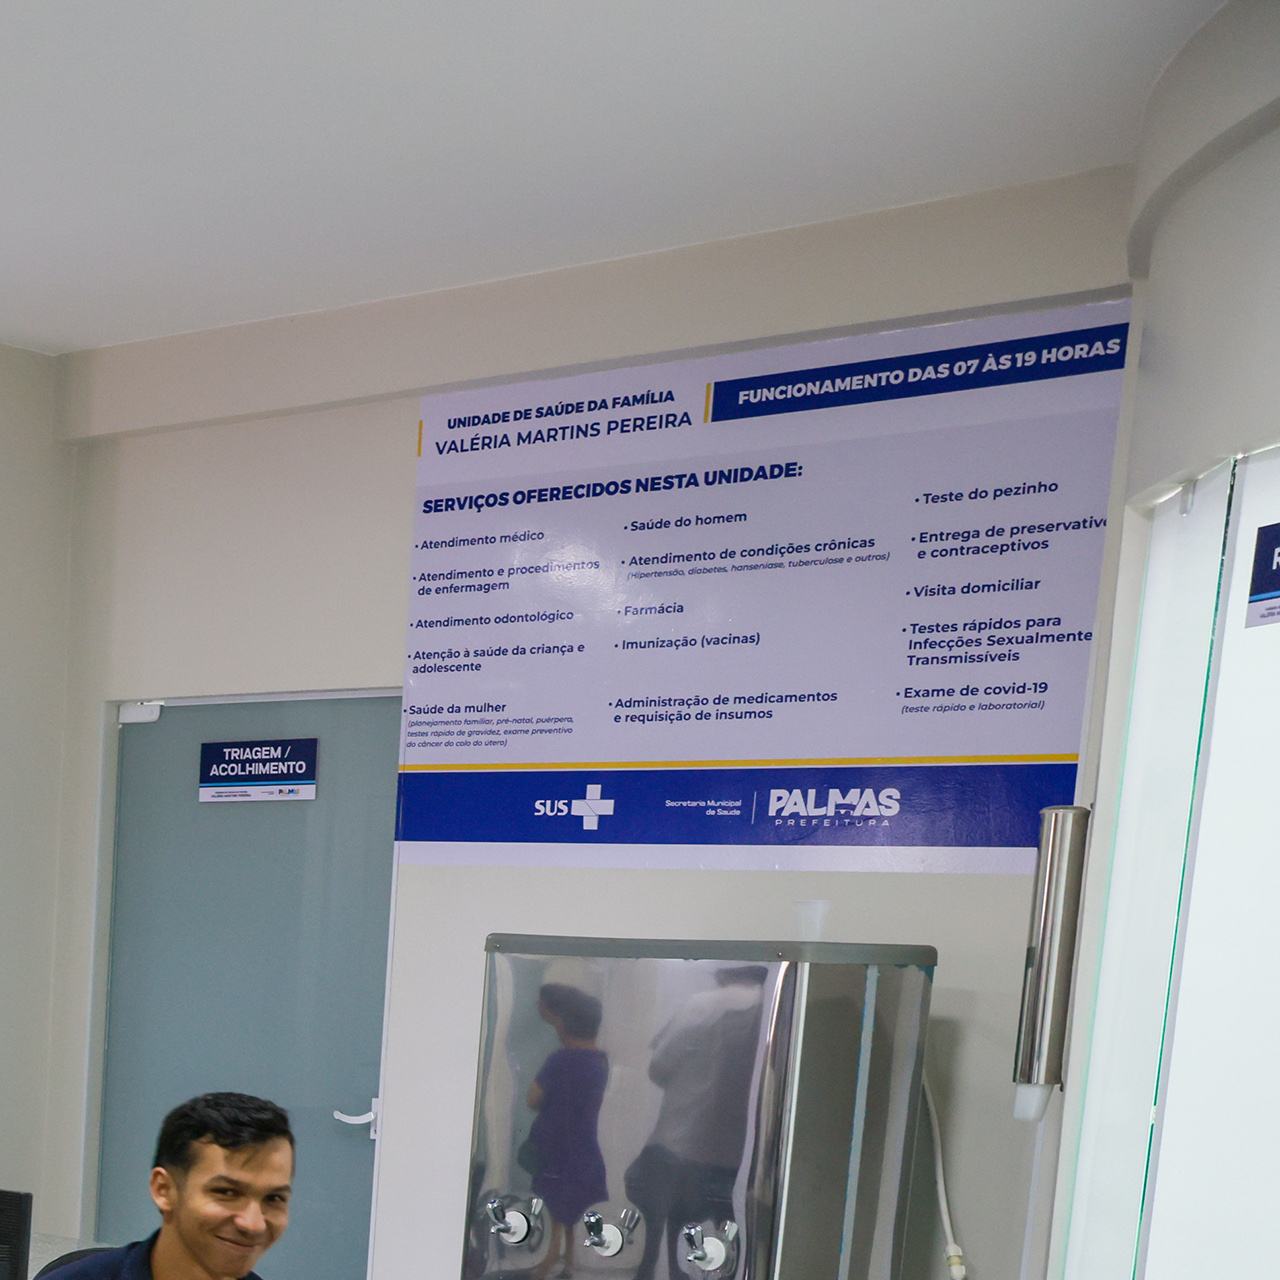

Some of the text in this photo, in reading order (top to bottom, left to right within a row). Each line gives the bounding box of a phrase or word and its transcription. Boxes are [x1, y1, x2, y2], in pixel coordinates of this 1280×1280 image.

[739, 338, 1121, 405] FUNCIONAMENTO DAS 07 ÀS 19 HORAS
[447, 390, 675, 429] UNIDADE DE SAÚDE DA FAMÍLIA
[436, 411, 692, 455] VALÉRIA MARTINS PEREIRA
[422, 462, 803, 513] SERVIÇOS OFERECIDOS NESTA UNIDADE:
[923, 481, 1058, 504] Teste do pezinho
[630, 512, 747, 531] Saúde do homem
[421, 531, 545, 550] Atendimento médico
[919, 529, 980, 544] Entrega
[985, 525, 1005, 538] de
[629, 537, 875, 566] Atendimento de condições crônicas
[917, 538, 1049, 559] e contraceptivos
[418, 568, 494, 582] Atendimento
[507, 561, 600, 578] procedimentos
[688, 565, 728, 576] diabetes,
[730, 561, 786, 572] hanseníase,
[788, 557, 844, 568] tuberculose
[854, 552, 890, 563] outros)
[418, 581, 510, 596] de enfermagem
[914, 578, 1041, 598] Visita domiciliar
[624, 603, 684, 616] Farmácia
[415, 609, 574, 629] Atendimento odontológico
[910, 617, 1061, 634] Testes rápidos para
[622, 632, 760, 650] Imunização (vacinas)
[908, 630, 1093, 651] Infecções Sexualmente
[413, 643, 585, 662] Atenção à saúde da criança e
[907, 649, 1020, 666] Transmissíveis
[412, 662, 482, 674] adolescente
[904, 682, 1048, 698] Exame de covid-19
[409, 702, 506, 715] Saúde da mulher
[614, 691, 838, 710] Administração de medicamentos
[901, 704, 930, 714] (teste
[932, 702, 966, 714] rápido
[978, 700, 1045, 711] laboratorial)
[408, 719, 462, 728] (planejamento
[496, 716, 534, 726] pré-natal,
[614, 708, 773, 725] e requisição de insumos
[407, 730, 429, 738] testes
[456, 728, 466, 736] de
[531, 727, 573, 737] preventivo
[406, 740, 416, 748] do
[444, 739, 454, 747] do
[456, 739, 471, 747] colo
[223, 748, 281, 760] TRIAGEM
[210, 761, 306, 776] ACOLHIMENTO
[534, 800, 569, 816] SUS
[665, 799, 742, 808] Secretaria Municipal
[768, 788, 901, 817] PALMAS
[776, 819, 890, 827] PREFEITURA
